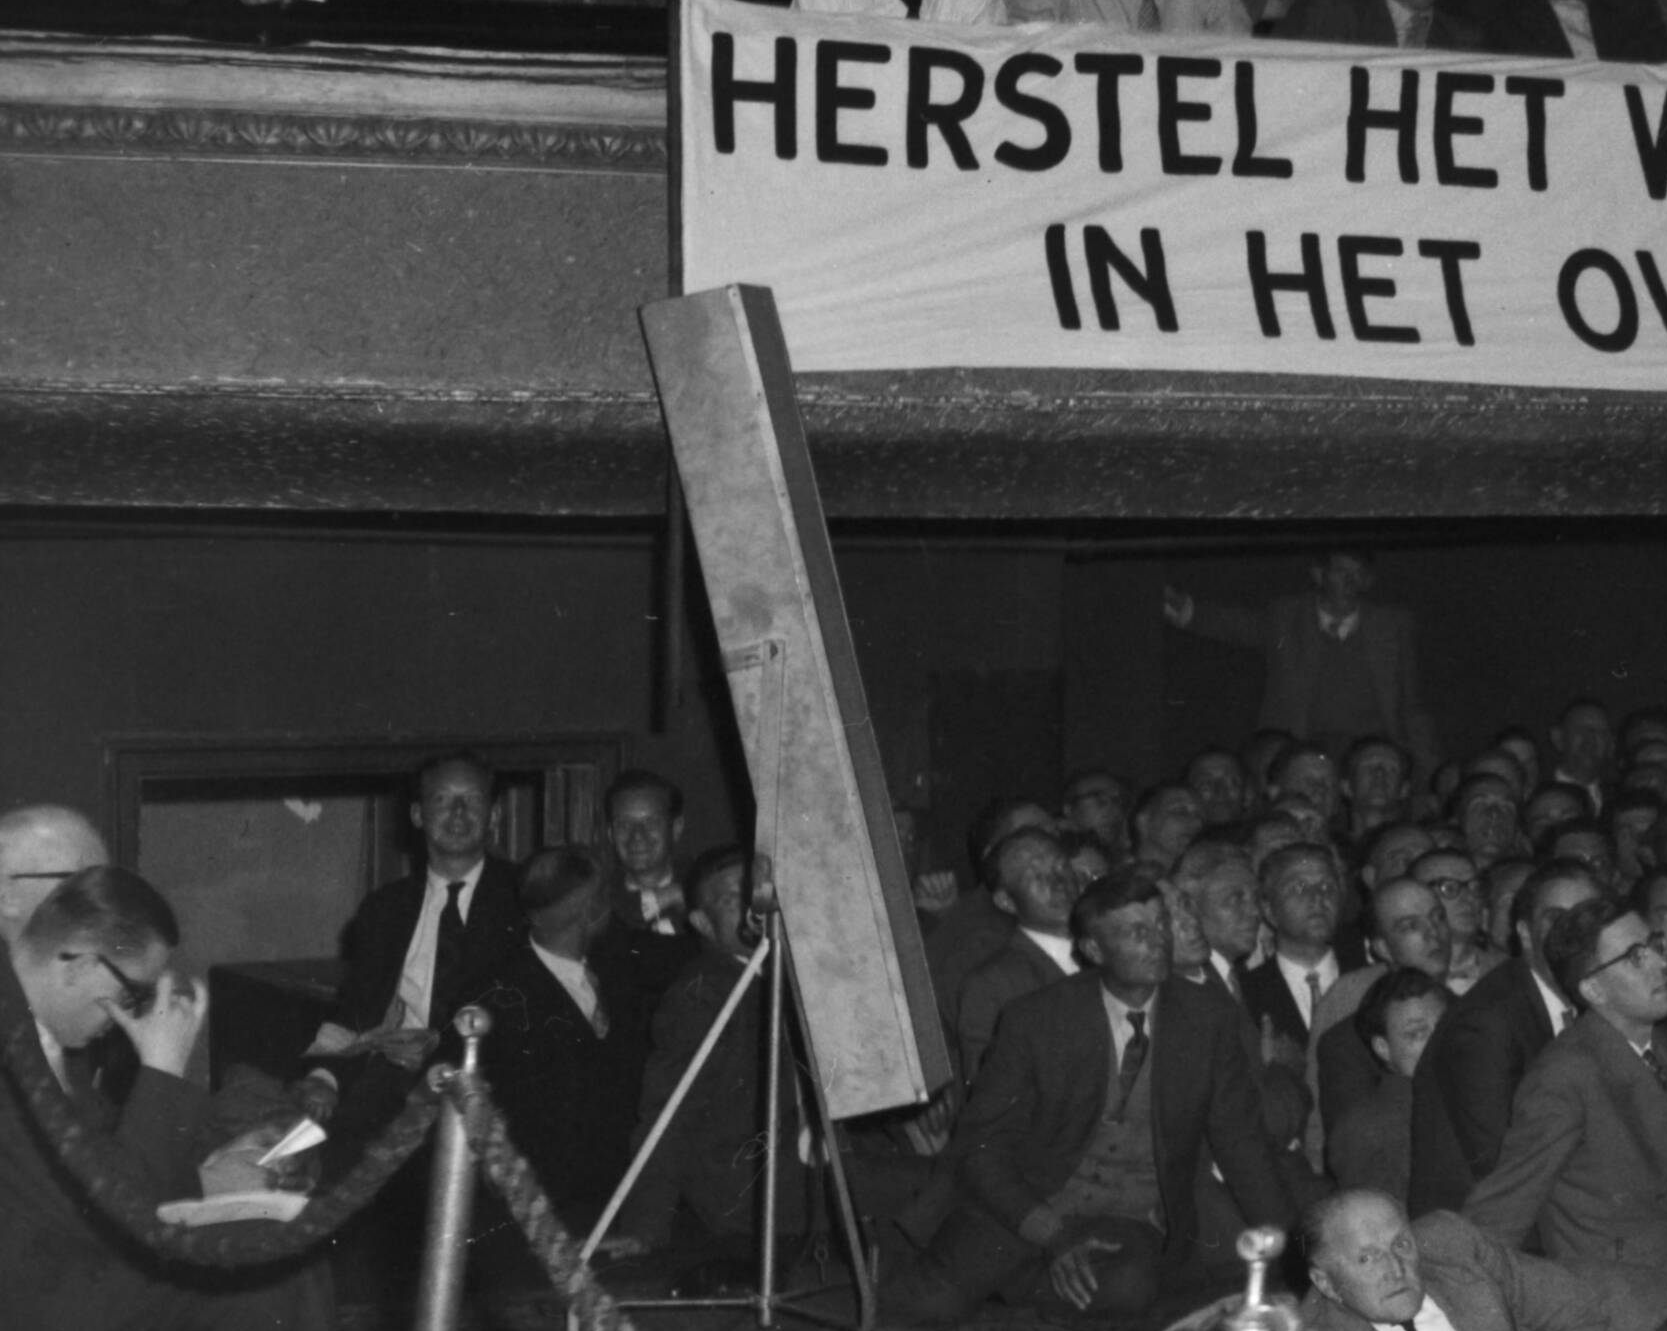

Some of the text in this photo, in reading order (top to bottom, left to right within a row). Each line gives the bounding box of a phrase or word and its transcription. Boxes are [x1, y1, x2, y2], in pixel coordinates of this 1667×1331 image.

[711, 31, 1294, 179] HERSTEL
[1345, 65, 1566, 192] HET
[1045, 223, 1180, 332] IN
[1245, 230, 1482, 346] HET
